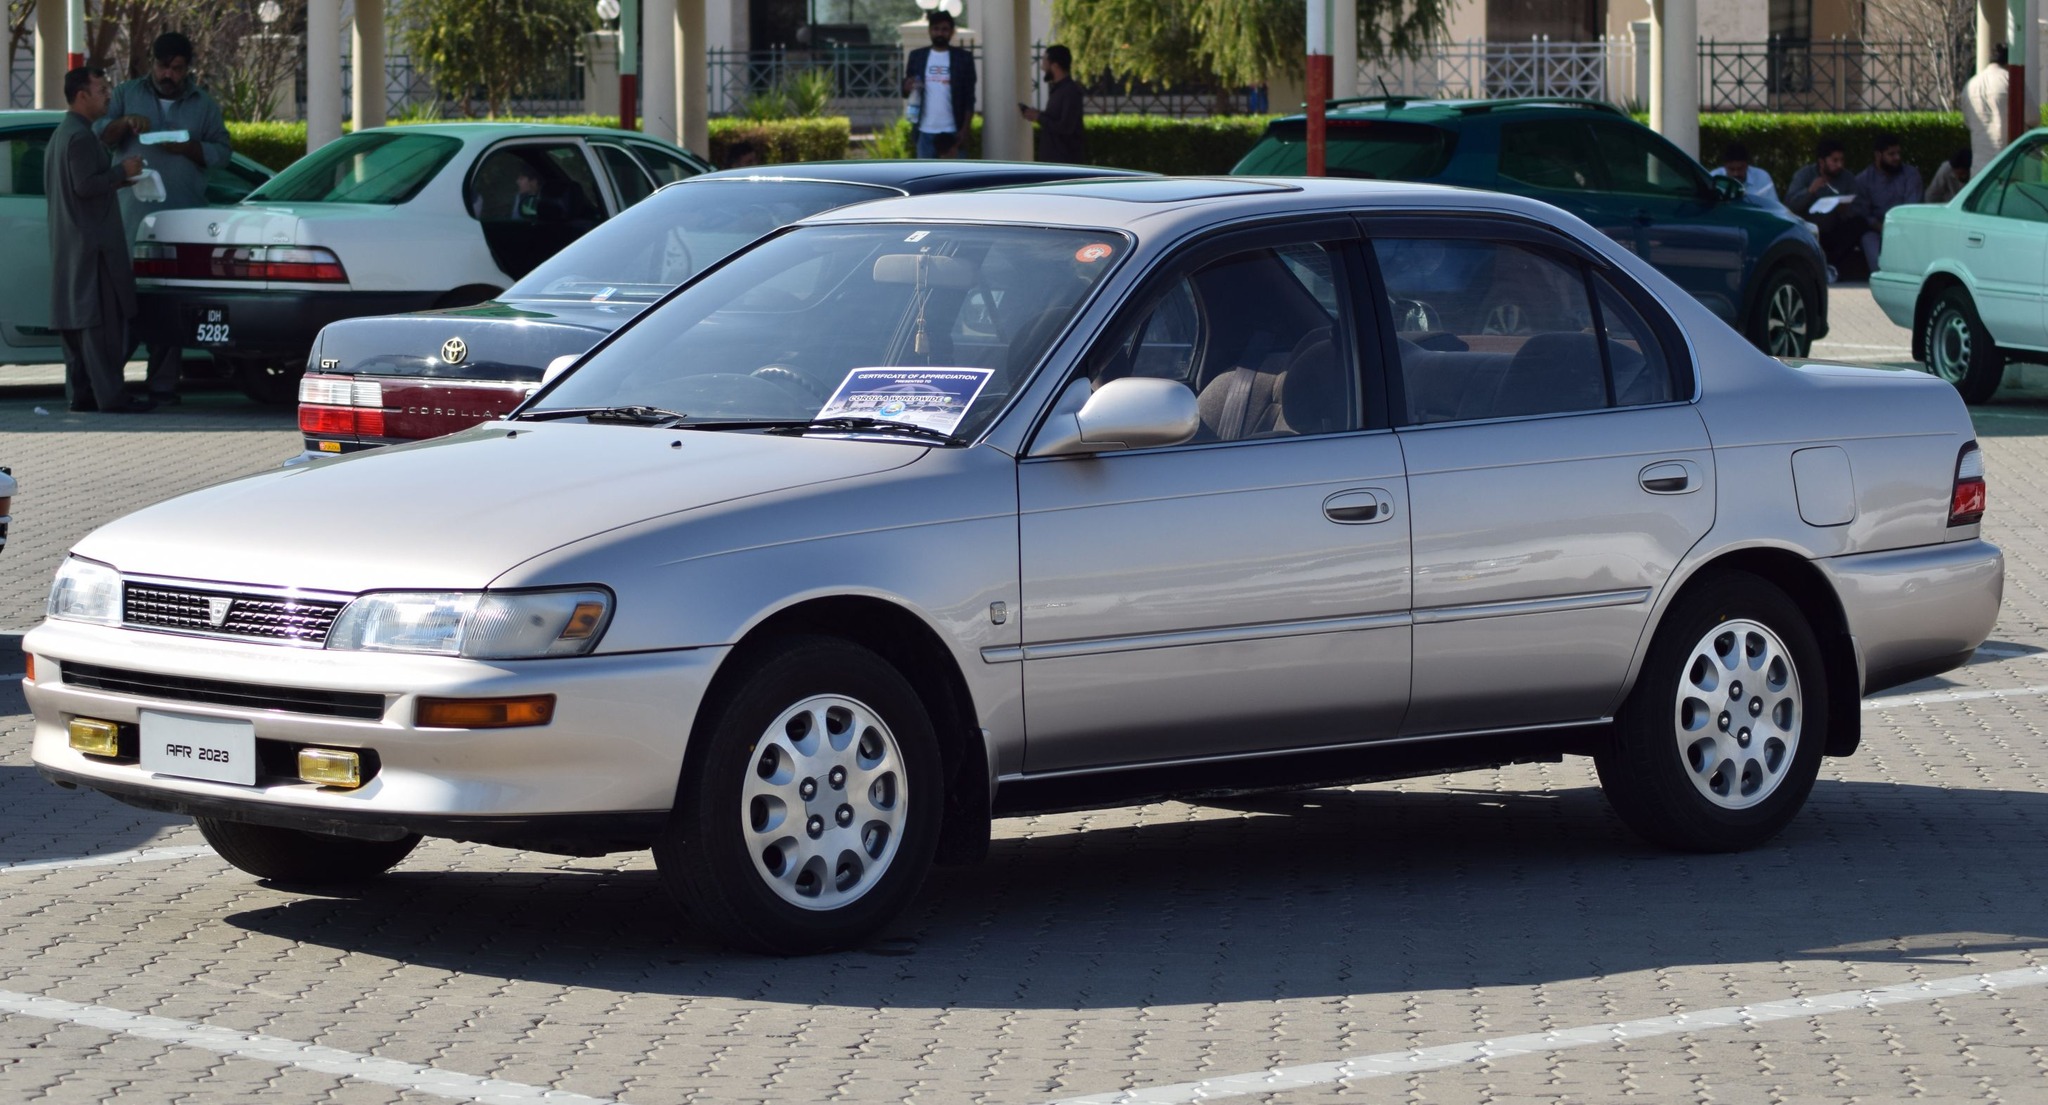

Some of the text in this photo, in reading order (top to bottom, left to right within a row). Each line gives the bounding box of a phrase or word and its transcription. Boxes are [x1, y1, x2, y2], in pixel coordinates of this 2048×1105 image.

[208, 310, 222, 322] IDH
[197, 323, 229, 342] 5282
[321, 359, 340, 369] GT
[918, 373, 978, 381] APPRECIATION
[848, 394, 889, 402] COROLLA
[408, 406, 493, 418] COROLLA
[166, 743, 229, 763] AFR 2023
